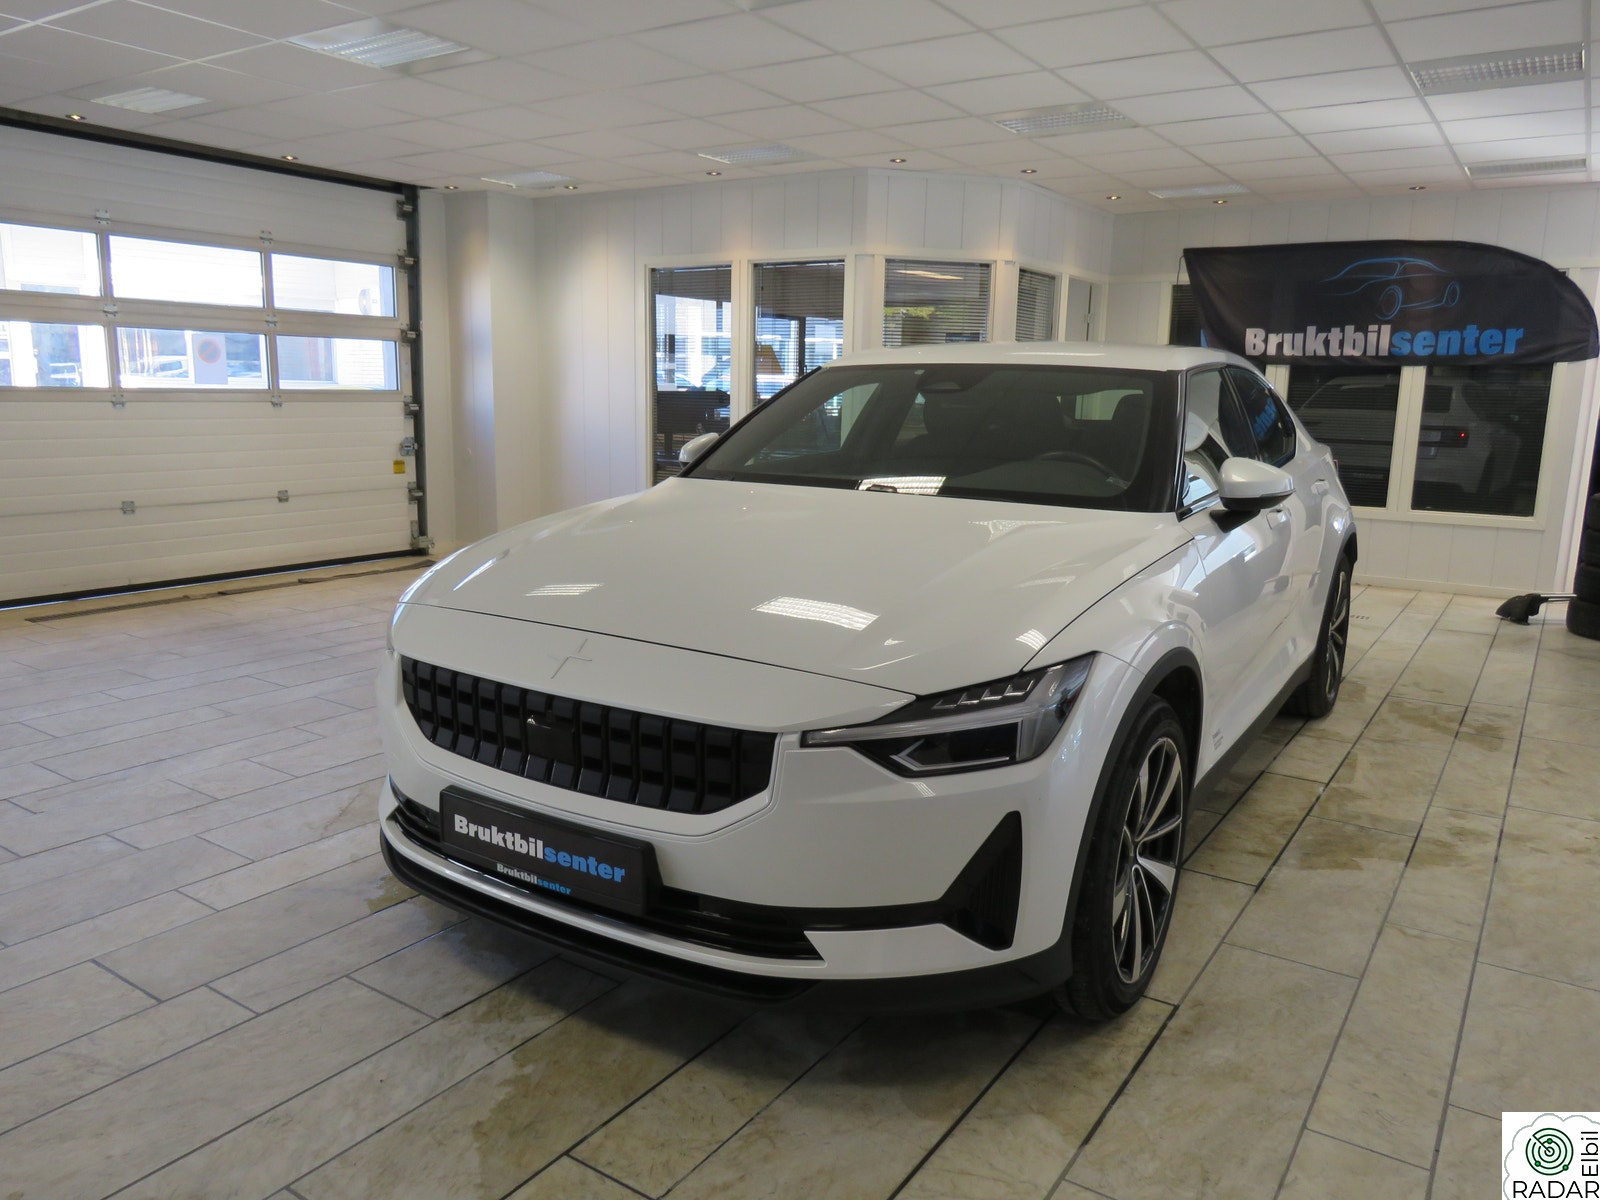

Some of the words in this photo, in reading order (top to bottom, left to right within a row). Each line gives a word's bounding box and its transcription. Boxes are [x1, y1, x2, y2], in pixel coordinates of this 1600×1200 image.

[1246, 325, 1523, 356] Bruktbilsenter
[454, 814, 625, 882] Bruktbilsenter
[497, 864, 571, 895] Bruktbilsenter
